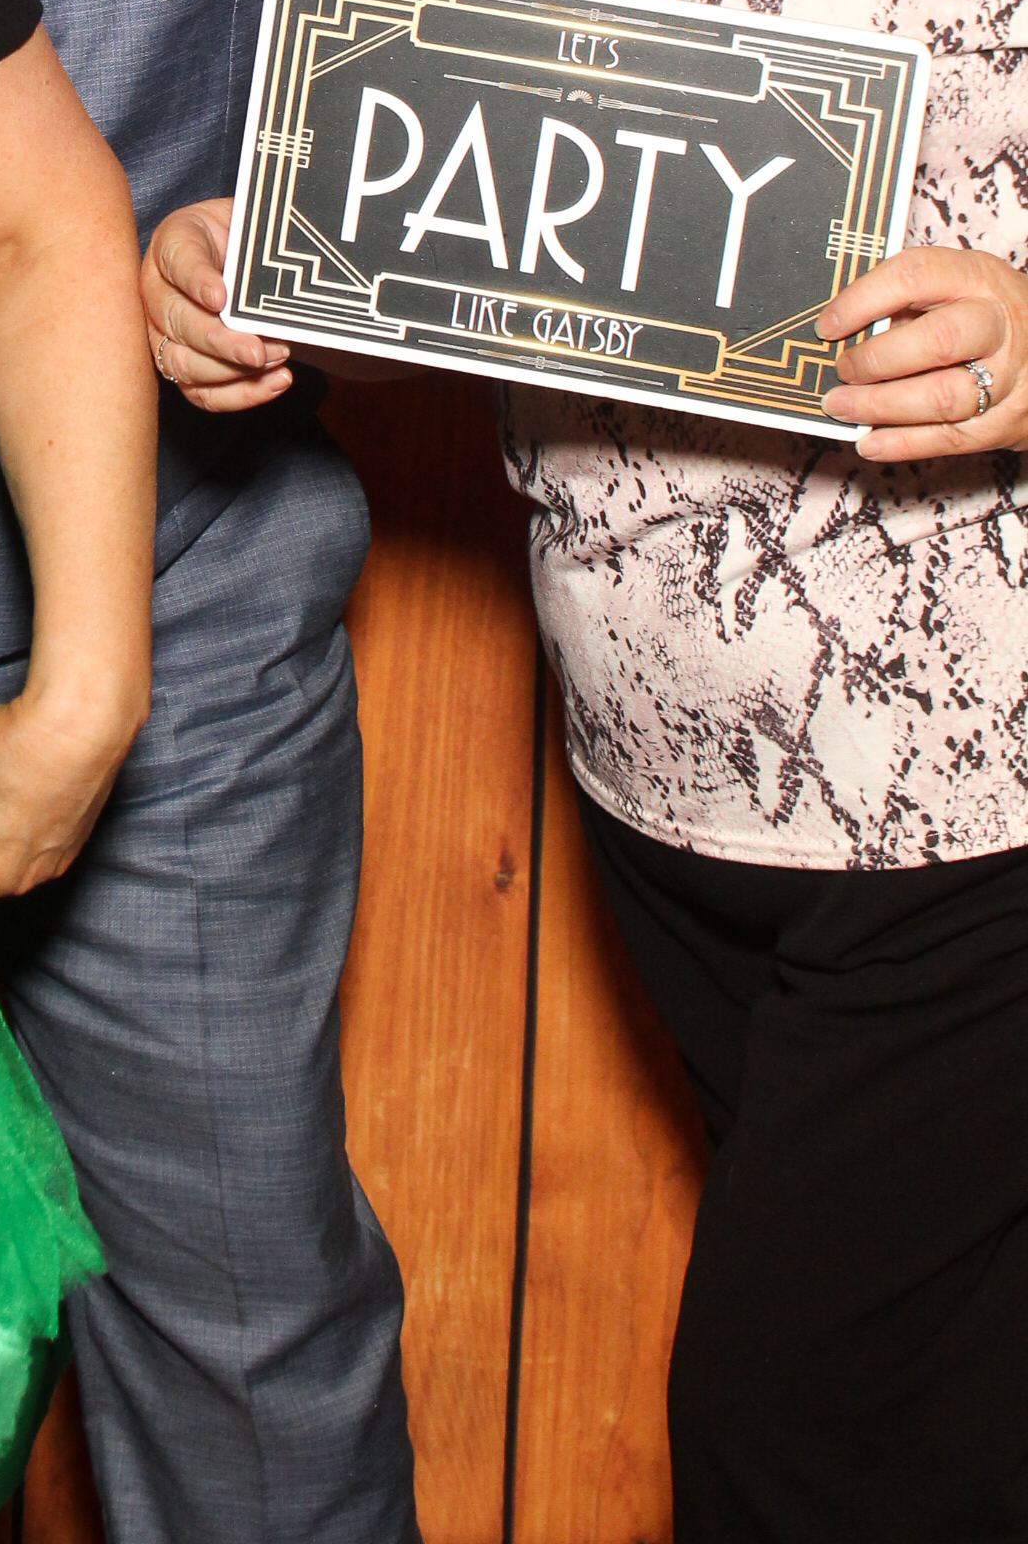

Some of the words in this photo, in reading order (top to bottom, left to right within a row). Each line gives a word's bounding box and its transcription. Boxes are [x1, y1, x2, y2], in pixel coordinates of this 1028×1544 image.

[557, 29, 620, 70] LET'S
[340, 86, 797, 309] PARTY
[452, 291, 519, 338] LIKE
[532, 309, 644, 360] GATSBY
